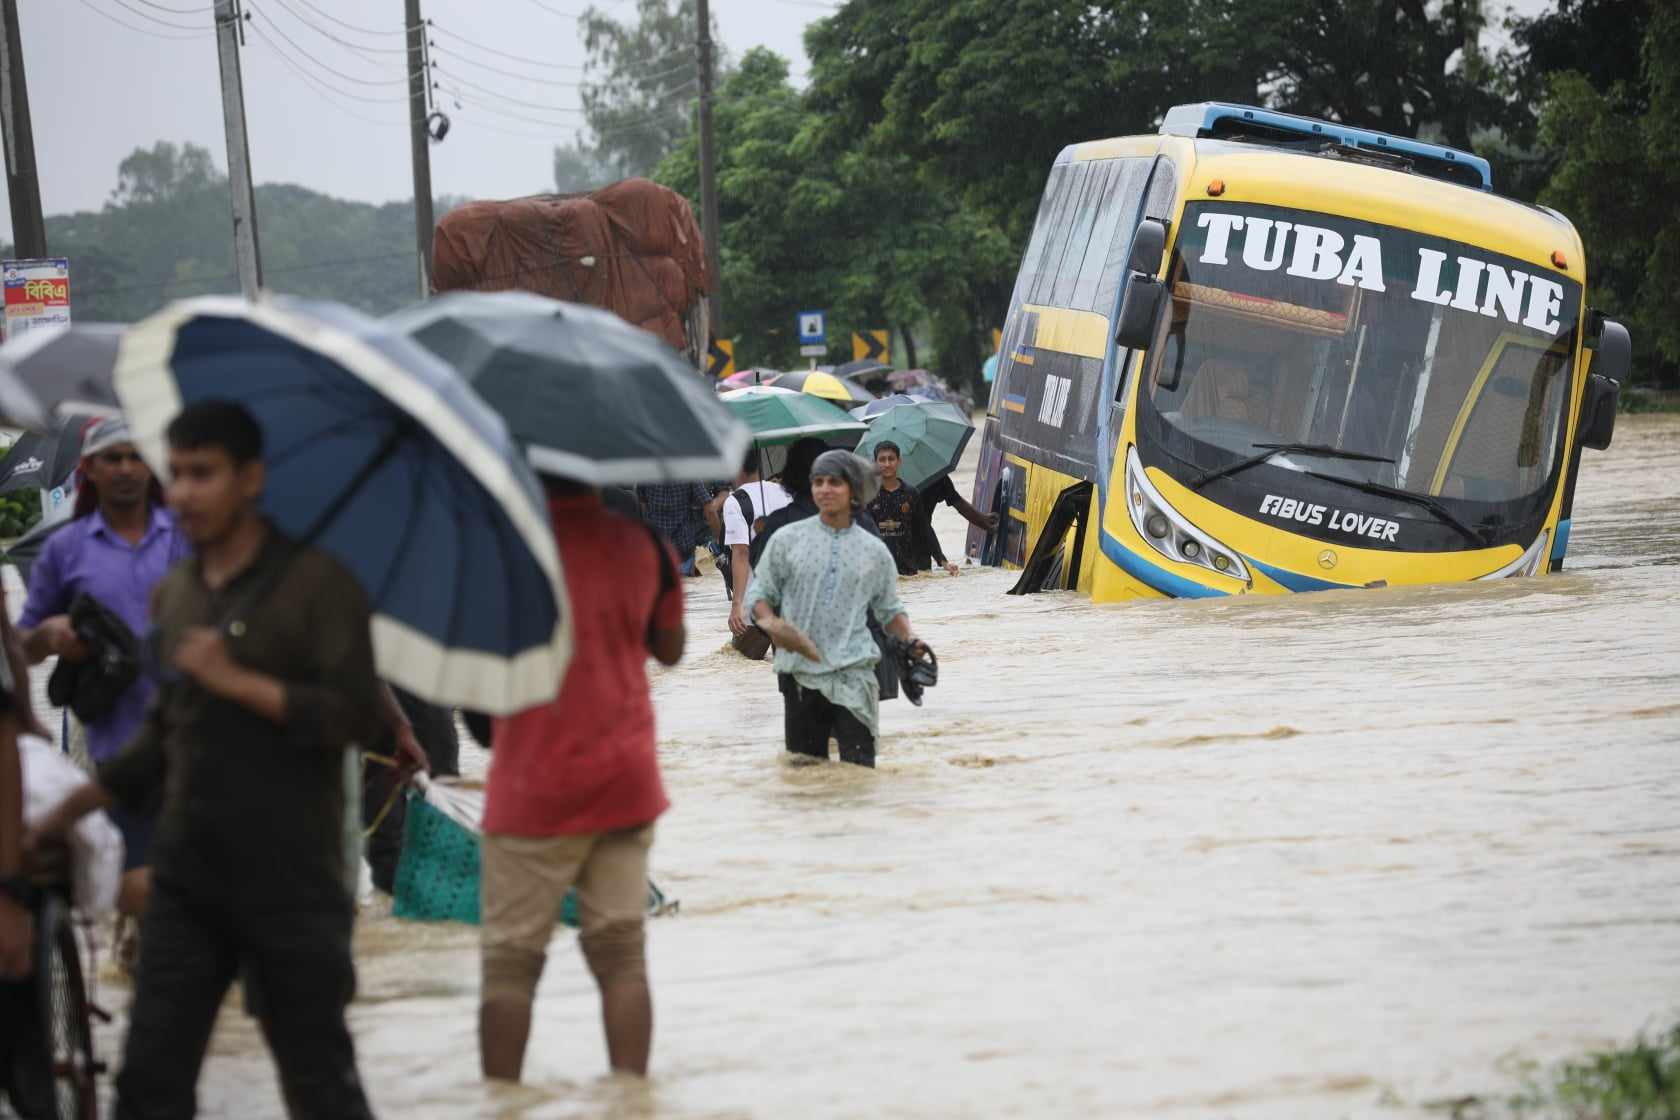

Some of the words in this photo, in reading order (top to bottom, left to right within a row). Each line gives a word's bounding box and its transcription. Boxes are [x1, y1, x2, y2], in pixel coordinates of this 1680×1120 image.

[1197, 212, 1386, 292] TUBA
[1411, 247, 1565, 335] LINE
[1328, 510, 1400, 543] LOVER
